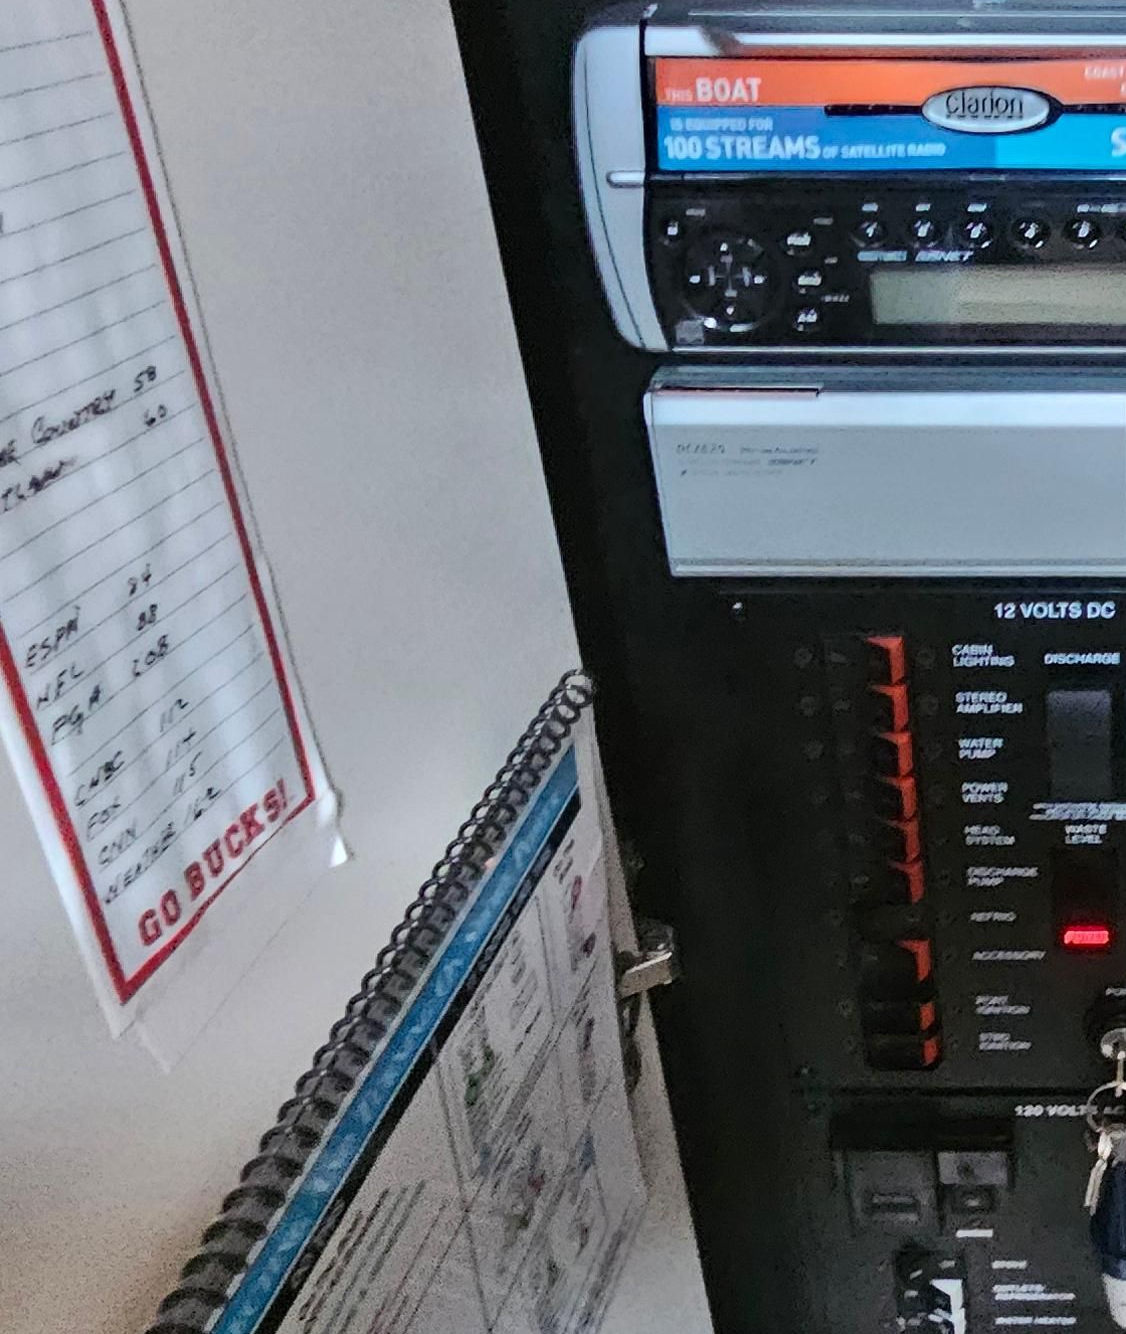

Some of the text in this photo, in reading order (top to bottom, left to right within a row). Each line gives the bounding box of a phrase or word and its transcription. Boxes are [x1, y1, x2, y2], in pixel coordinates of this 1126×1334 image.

[665, 77, 762, 103] THIS BOAT
[749, 117, 773, 130] FOR
[664, 136, 701, 160] 100
[705, 135, 820, 160] STREAMS
[840, 145, 905, 158] SATELLITE
[907, 143, 946, 157] RADIO
[995, 602, 1116, 618] 12 VOLTS DC
[952, 644, 993, 656] CABIN
[953, 655, 1015, 667] LIGHTING
[1044, 653, 1120, 665] DISCHARGE
[955, 691, 1008, 703] STEREO
[956, 703, 1023, 713] AMPLIFIER
[958, 738, 1004, 748] WATER
[959, 748, 997, 759] PUMP
[138, 777, 288, 947] GO BUCKS!
[1015, 1105, 1044, 1117] 120
